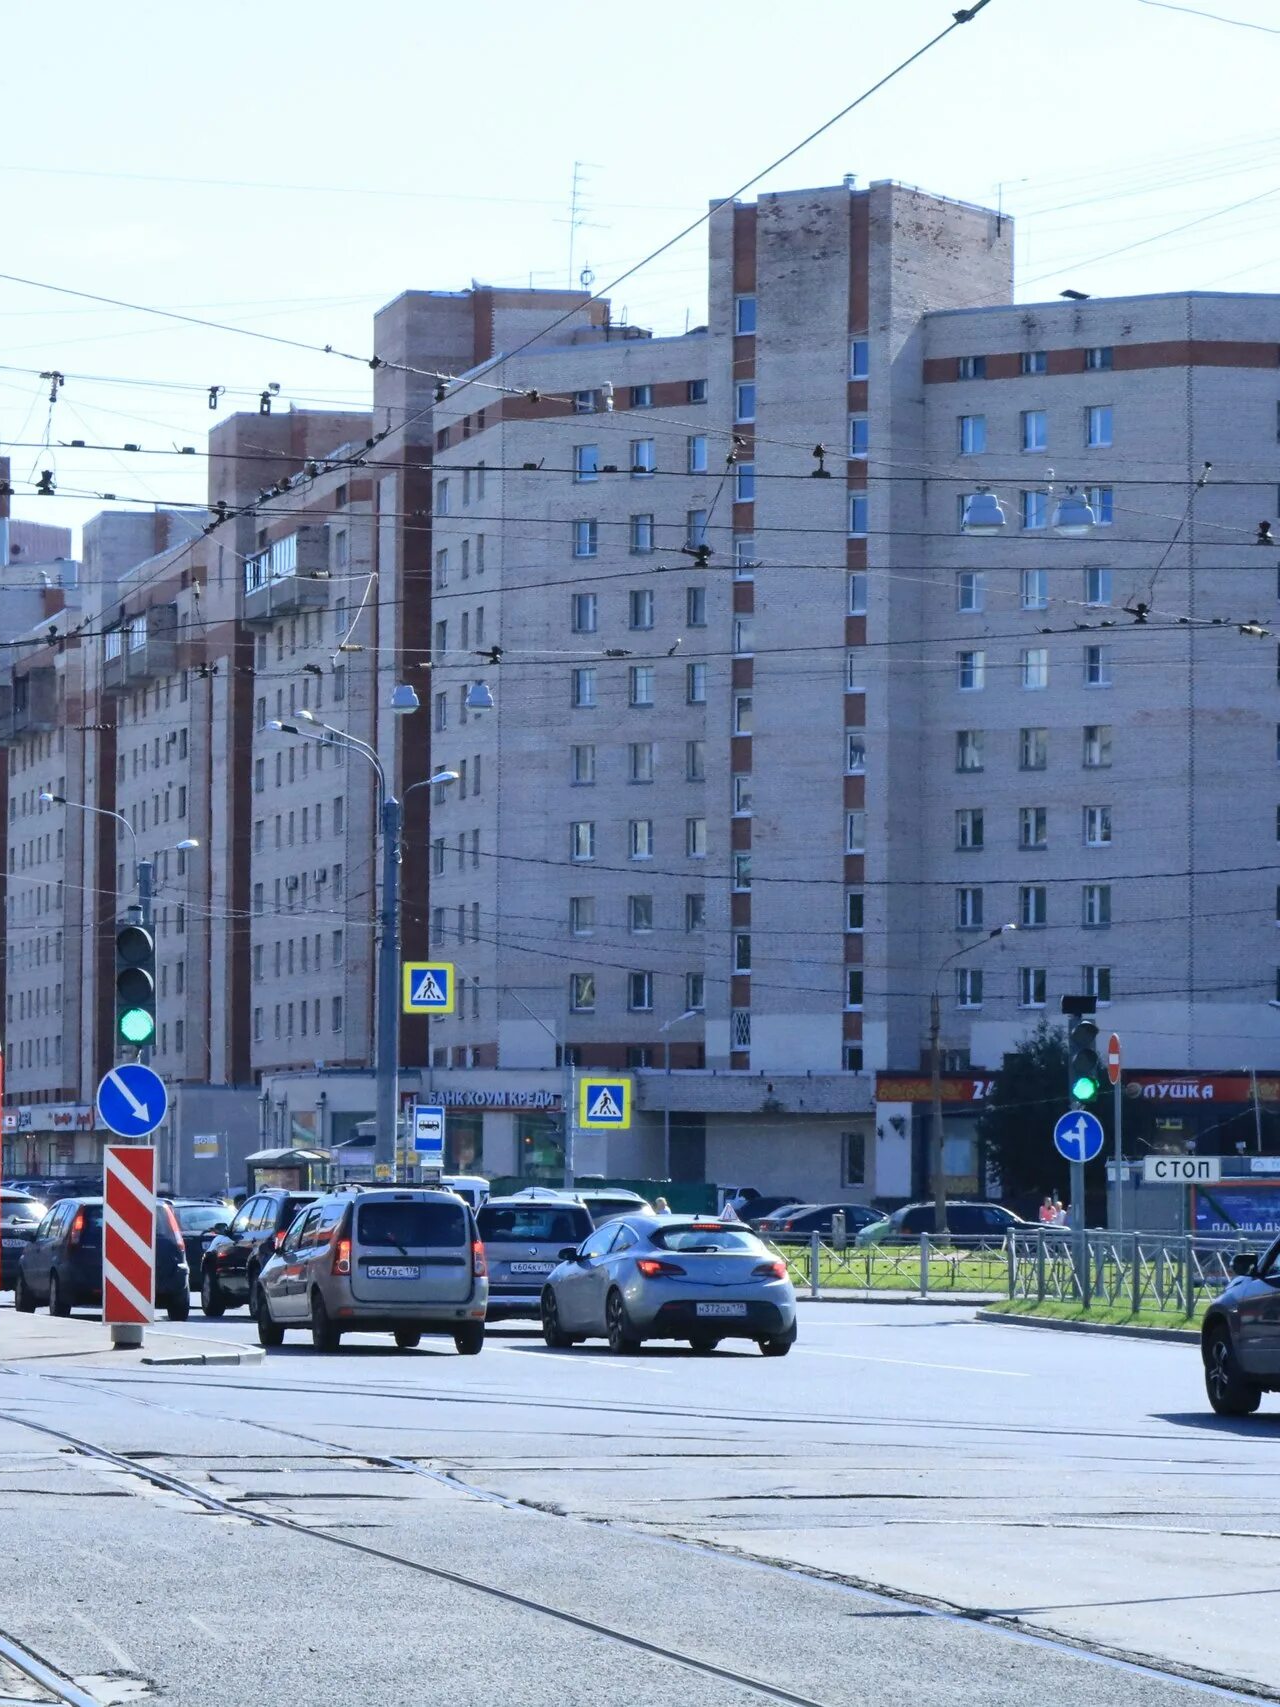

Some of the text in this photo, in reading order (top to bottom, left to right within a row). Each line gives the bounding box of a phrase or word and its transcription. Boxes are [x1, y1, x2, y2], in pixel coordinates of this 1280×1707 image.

[428, 1091, 466, 1105] БАНК
[467, 1091, 506, 1105] ХОУМ
[1155, 1161, 1209, 1178] СТОП
